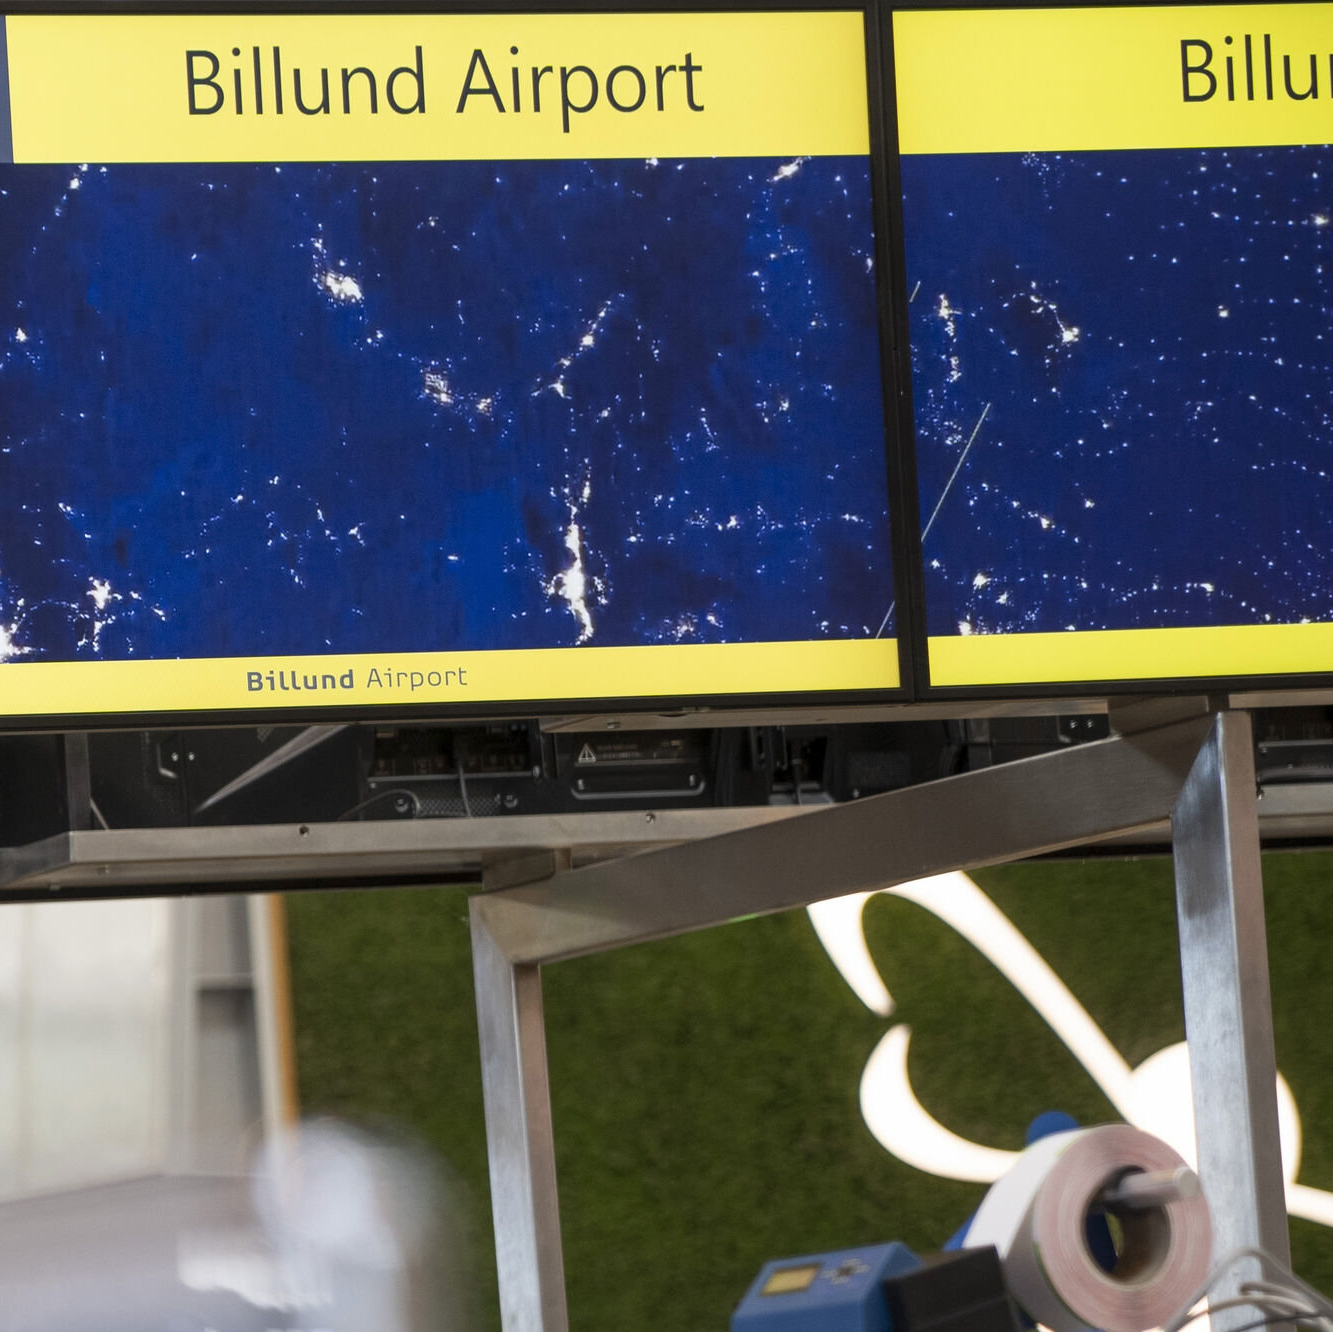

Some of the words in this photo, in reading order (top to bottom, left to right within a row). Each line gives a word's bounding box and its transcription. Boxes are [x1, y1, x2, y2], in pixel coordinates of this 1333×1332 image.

[186, 46, 425, 116] Billund
[456, 46, 705, 133] Airport
[1180, 33, 1333, 103] Billu
[246, 668, 354, 692] Billund
[366, 667, 468, 692] Airport
